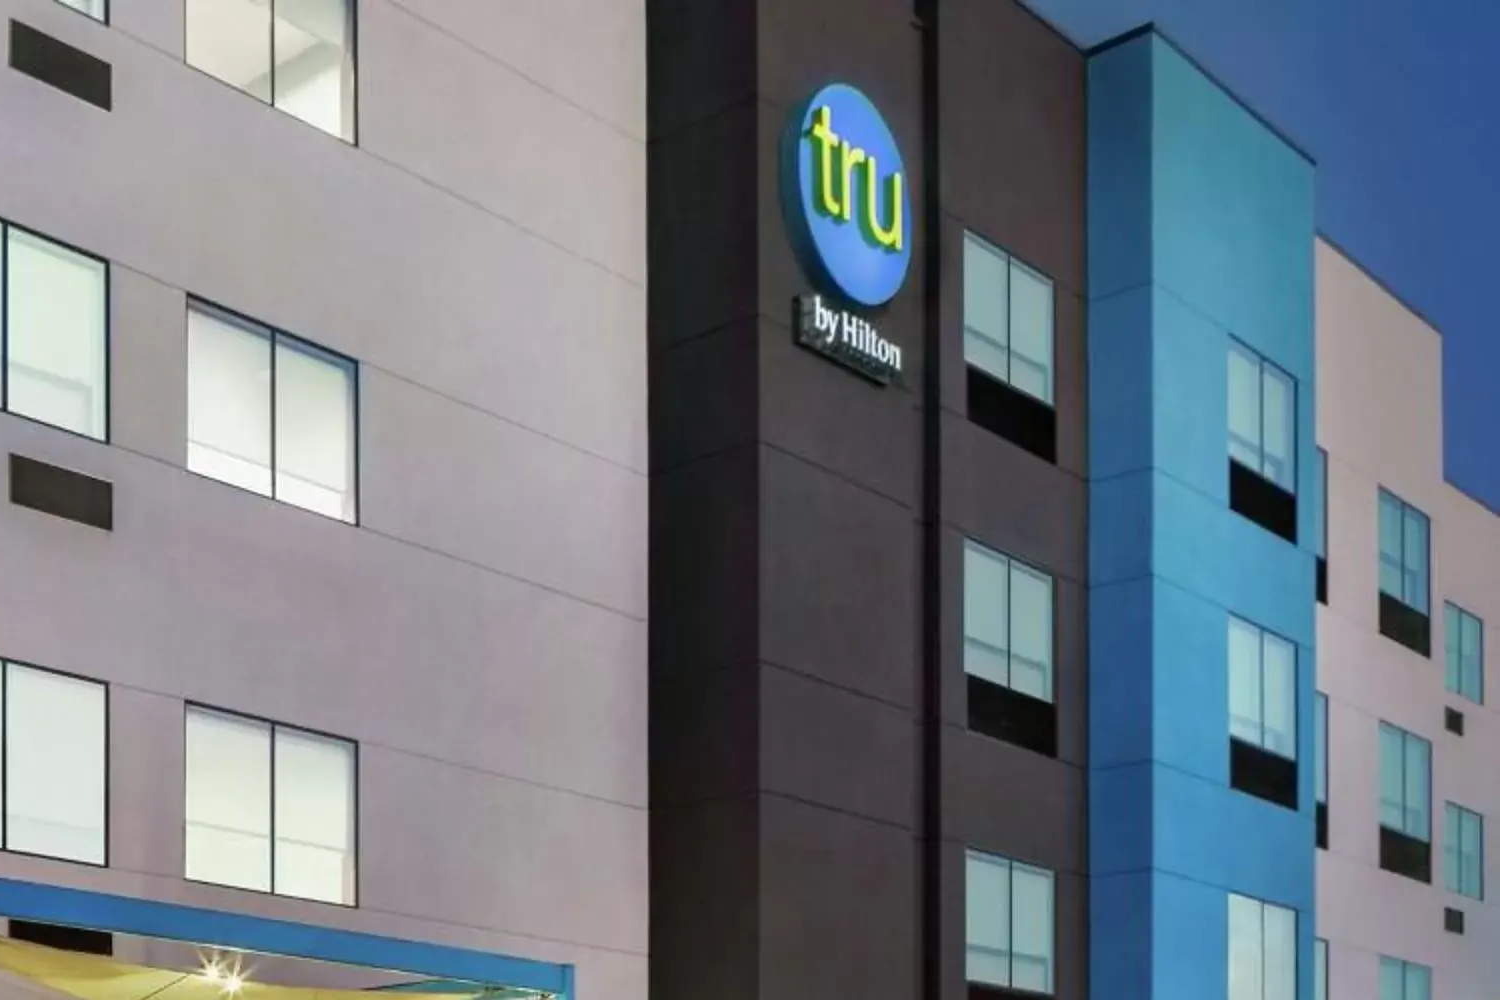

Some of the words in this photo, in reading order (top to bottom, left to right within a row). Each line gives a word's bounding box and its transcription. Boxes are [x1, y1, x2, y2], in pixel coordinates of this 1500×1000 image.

[811, 104, 902, 251] tru
[814, 294, 840, 344] by
[842, 310, 902, 370] Hilton
